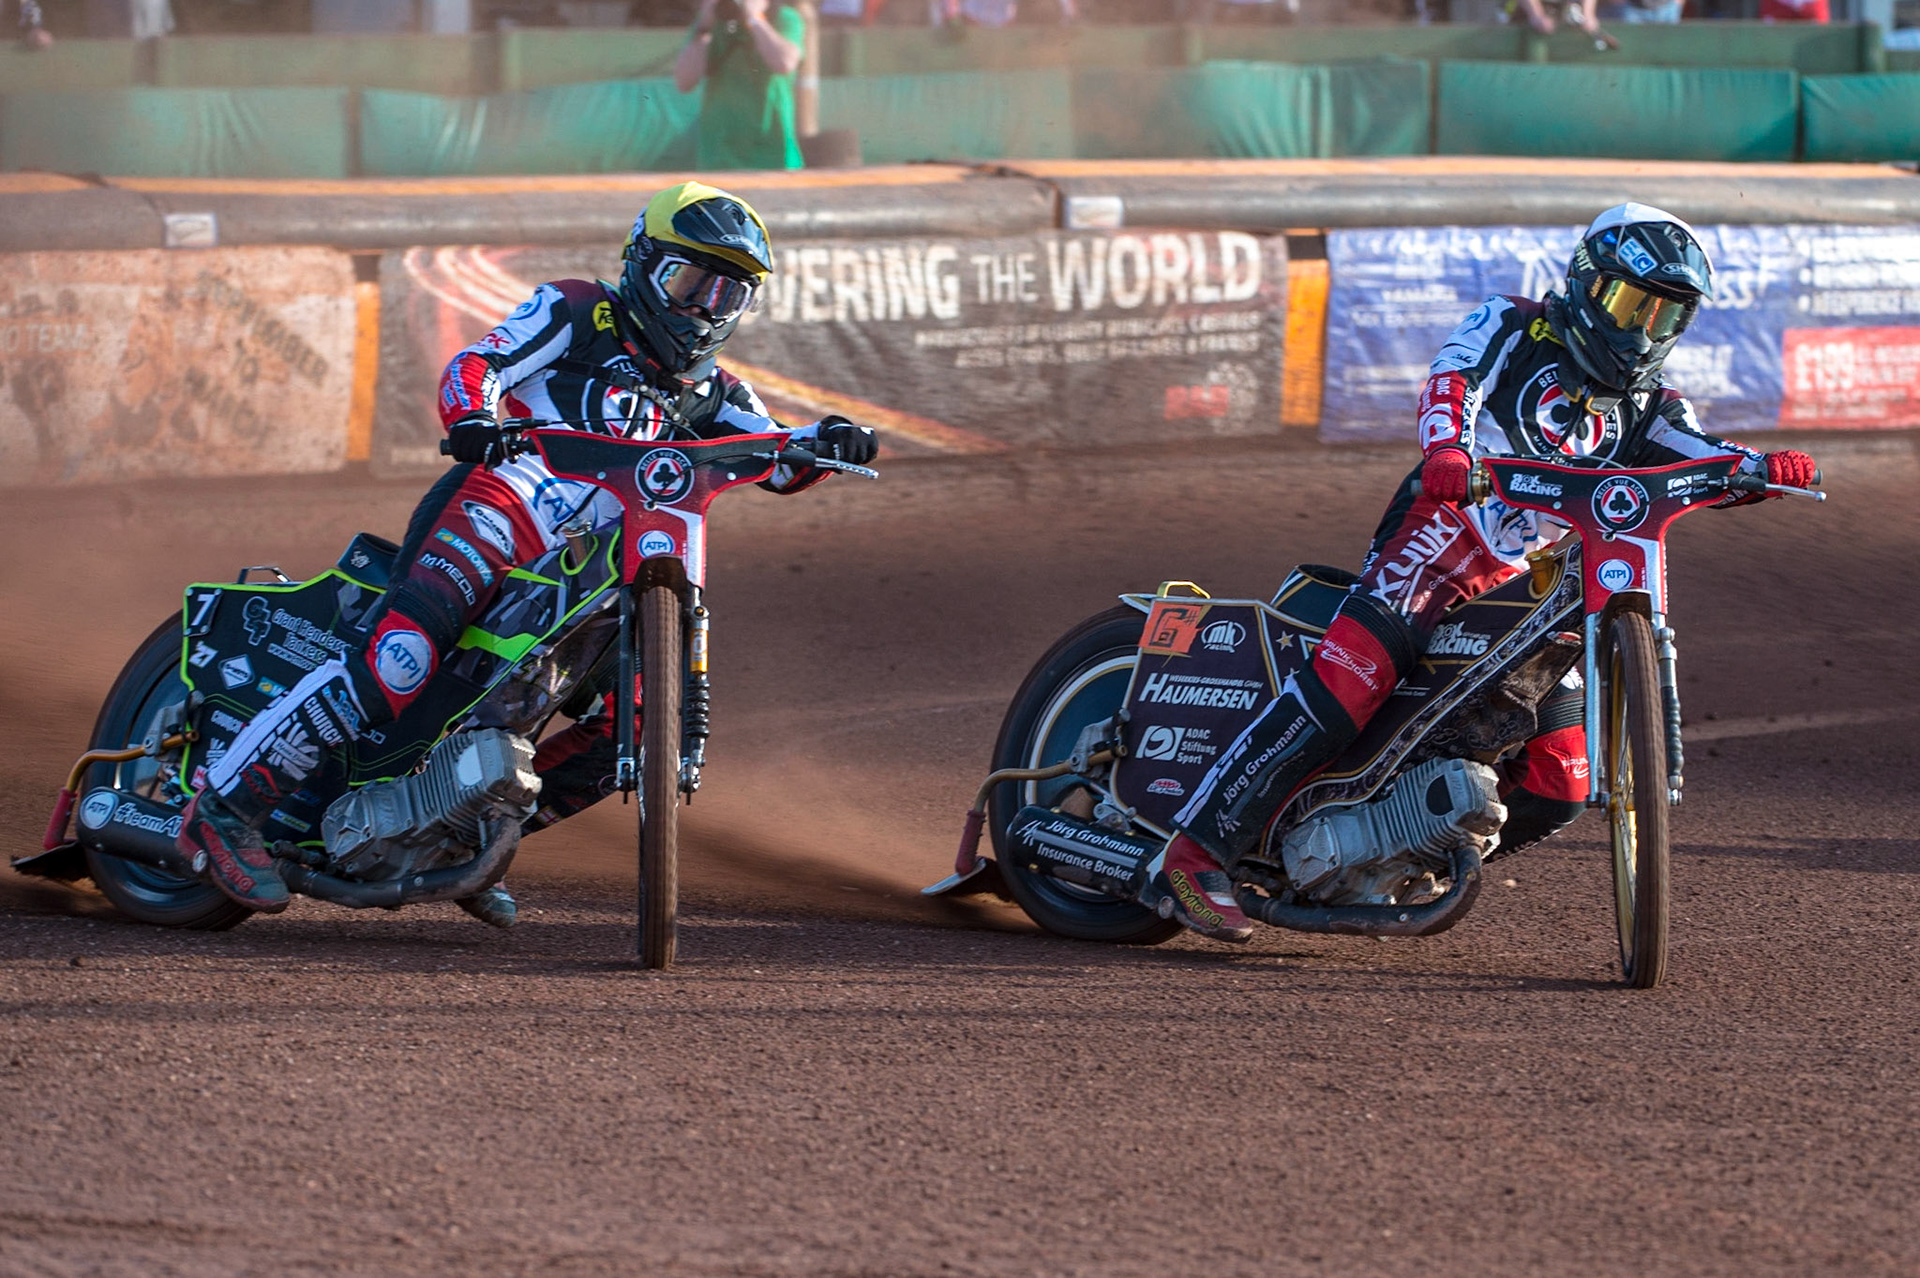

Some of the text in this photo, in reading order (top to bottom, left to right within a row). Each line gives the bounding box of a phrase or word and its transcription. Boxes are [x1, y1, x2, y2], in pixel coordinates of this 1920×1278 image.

[741, 231, 1263, 324] VERING THE WORLD
[640, 452, 658, 472] BELLE
[658, 450, 675, 459] VUE
[1509, 481, 1563, 497] RACING
[1595, 479, 1646, 500] BELLE VUE ACES
[644, 541, 668, 551] ATPI
[1603, 569, 1627, 579] ATPI
[190, 594, 217, 626] 7
[1207, 621, 1237, 646] mk
[282, 631, 328, 665] Tankers
[1426, 638, 1489, 656] RACING
[385, 642, 421, 680] ATPI
[1138, 672, 1259, 711] HAUMERSEN
[1185, 727, 1212, 740] ADAC
[1176, 751, 1204, 765] Sport
[1180, 740, 1218, 756] Stiftung
[1222, 714, 1308, 806] Jörg Grohmann
[86, 801, 112, 816] ATPI
[1045, 819, 1146, 858] Jörg Grohmann
[1036, 842, 1135, 882] Insurance Broker
[1169, 867, 1226, 929] daytona
